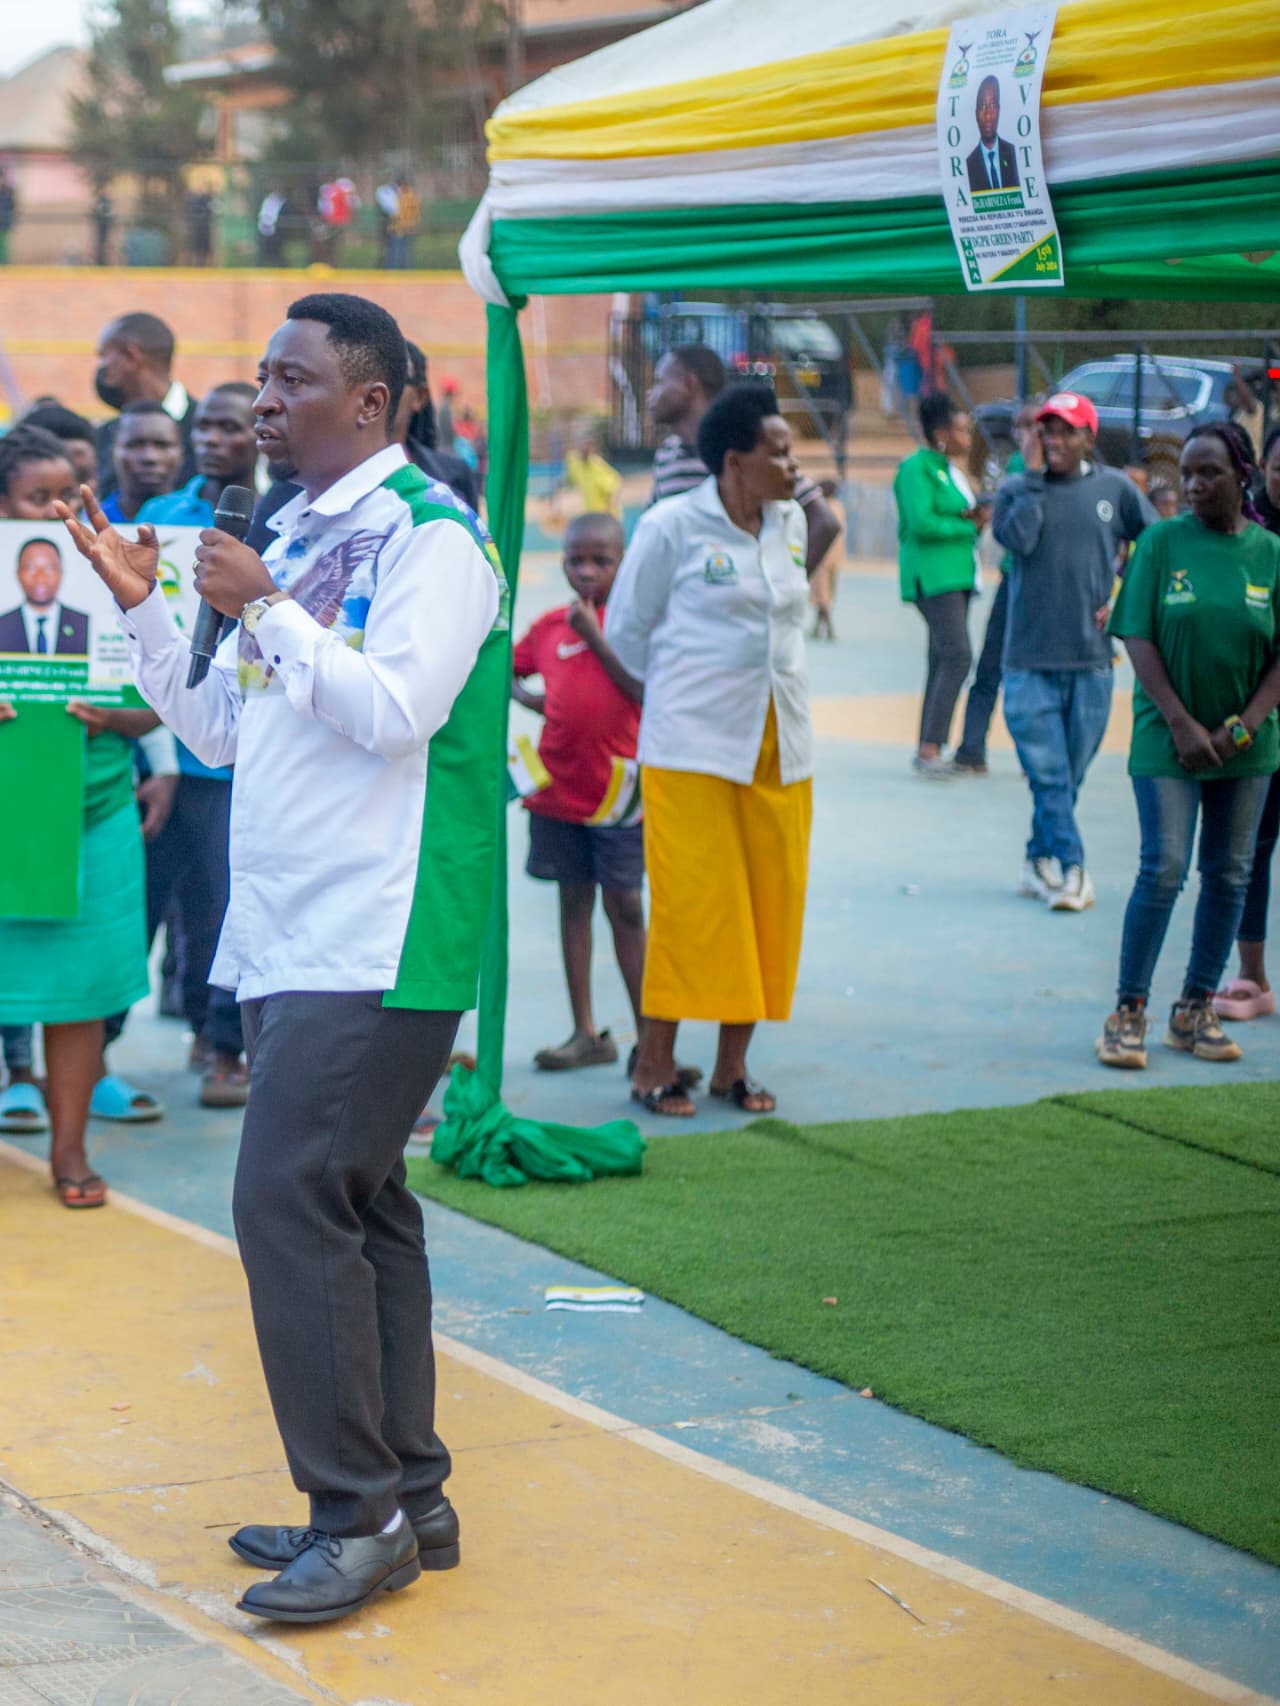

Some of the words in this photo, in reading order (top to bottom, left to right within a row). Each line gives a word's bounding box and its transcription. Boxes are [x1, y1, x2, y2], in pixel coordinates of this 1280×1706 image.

[947, 95, 968, 207] TORA
[1017, 83, 1039, 199] VOTE
[1013, 230, 1035, 243] PARTY
